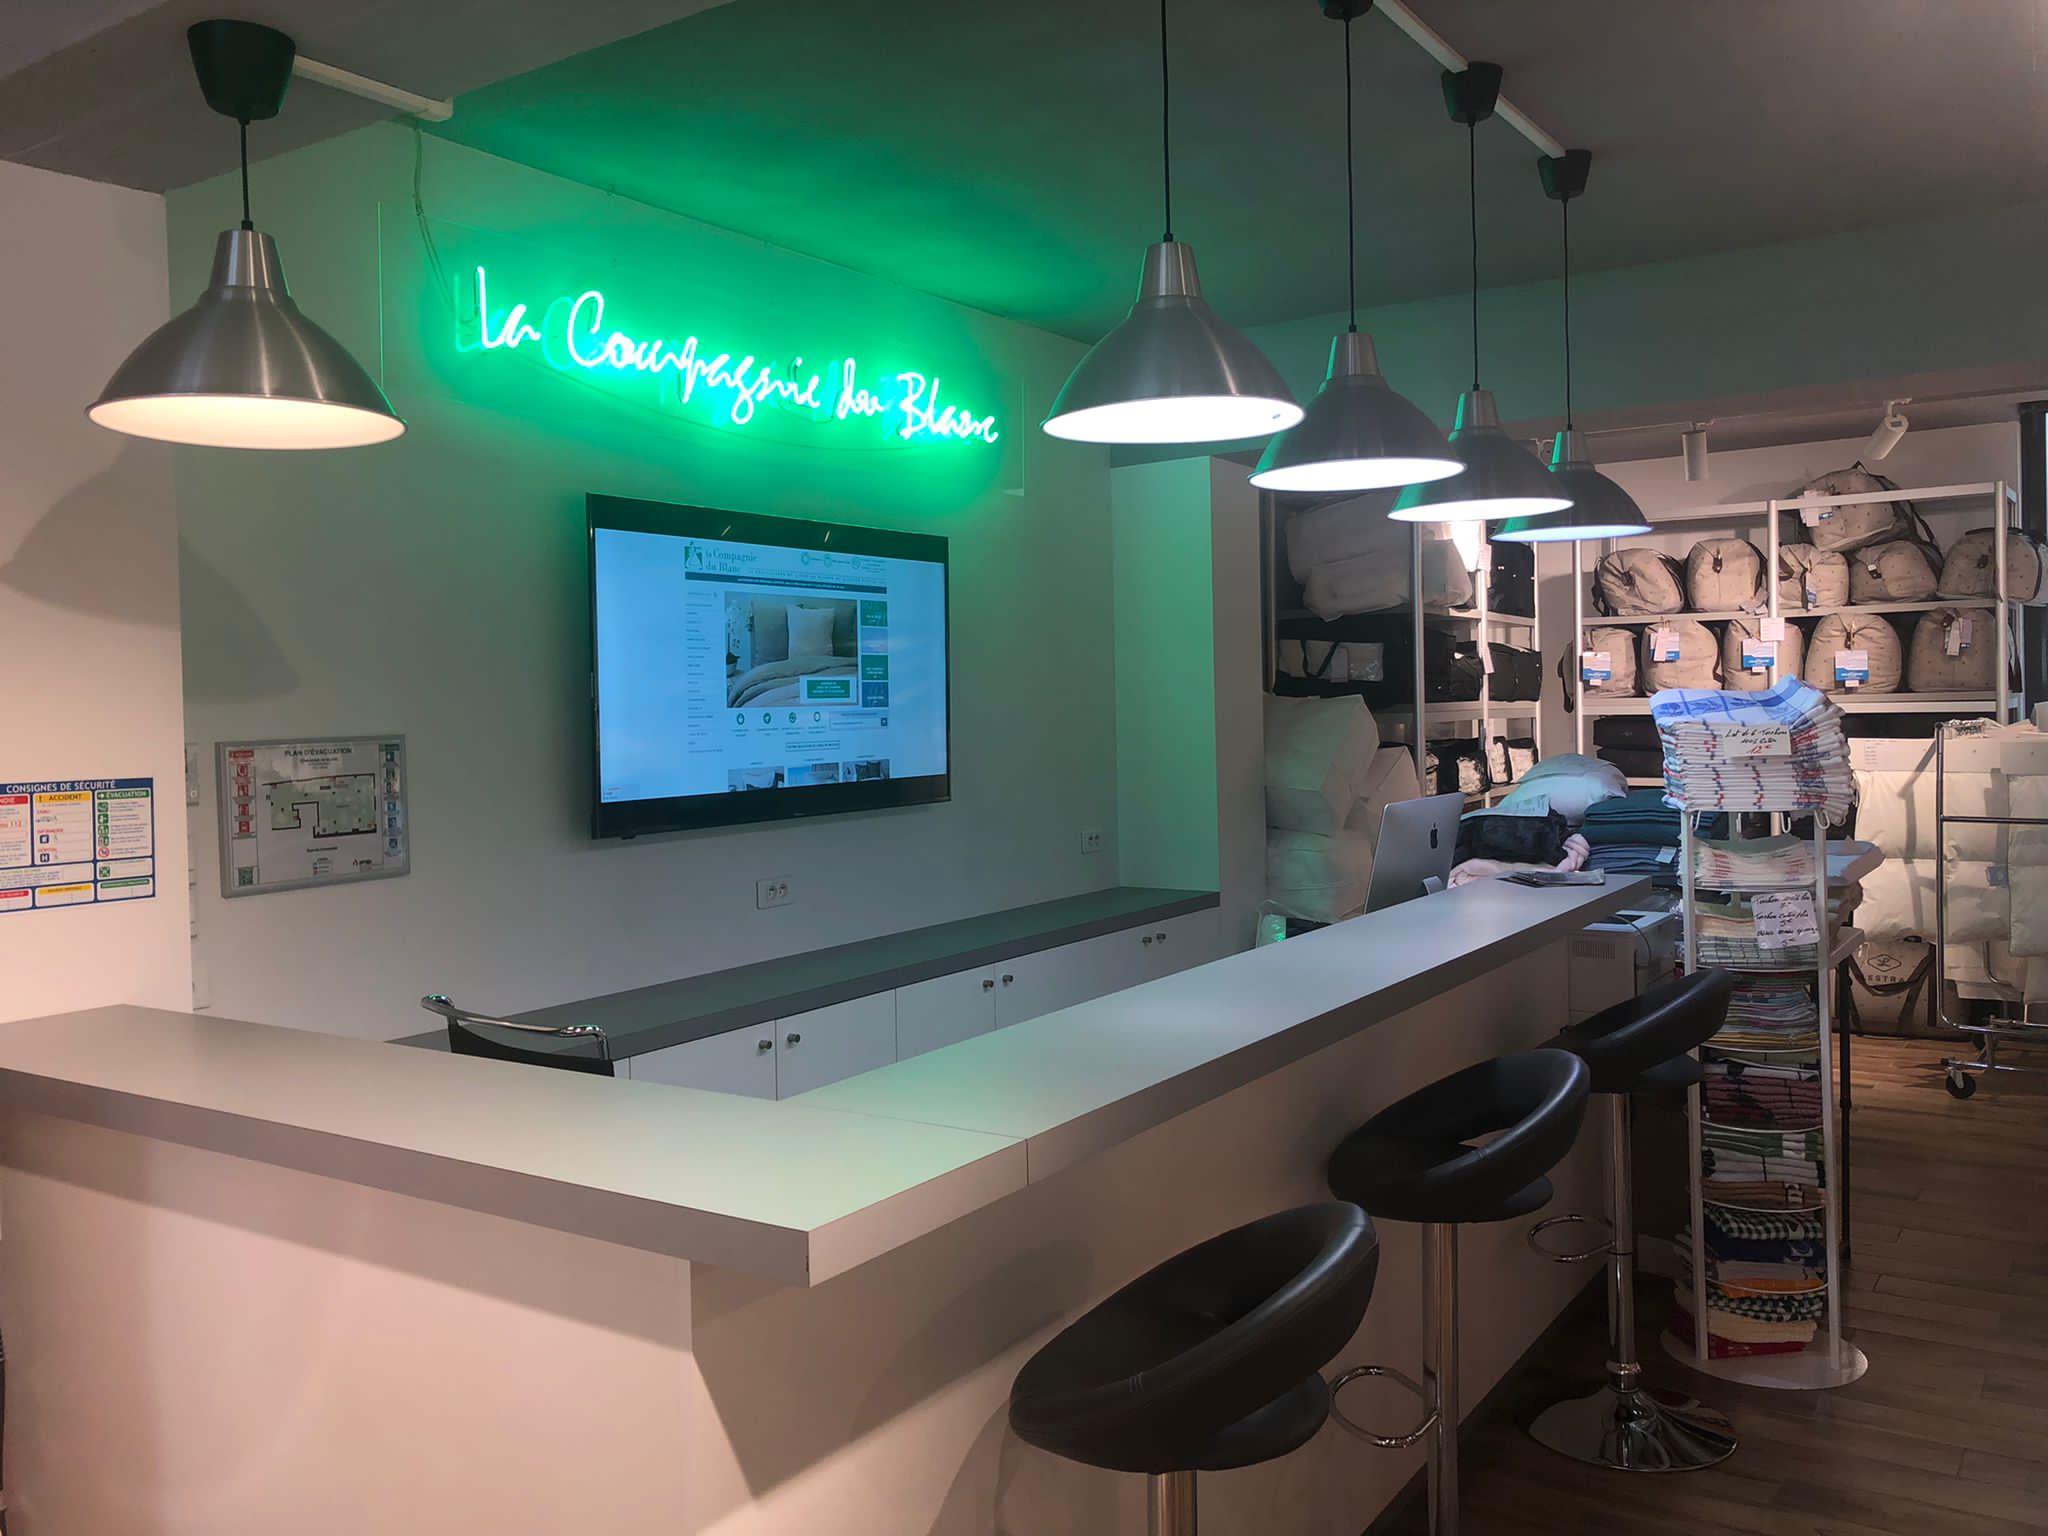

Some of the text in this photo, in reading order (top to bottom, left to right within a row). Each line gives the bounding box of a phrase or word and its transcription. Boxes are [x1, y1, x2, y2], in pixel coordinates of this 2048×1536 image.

[476, 265, 999, 443] La Compagnie du Blanc
[712, 547, 760, 564] Compagnie
[719, 562, 741, 574] Blanc
[6, 783, 58, 794] CONSIGNES
[59, 782, 73, 792] DE
